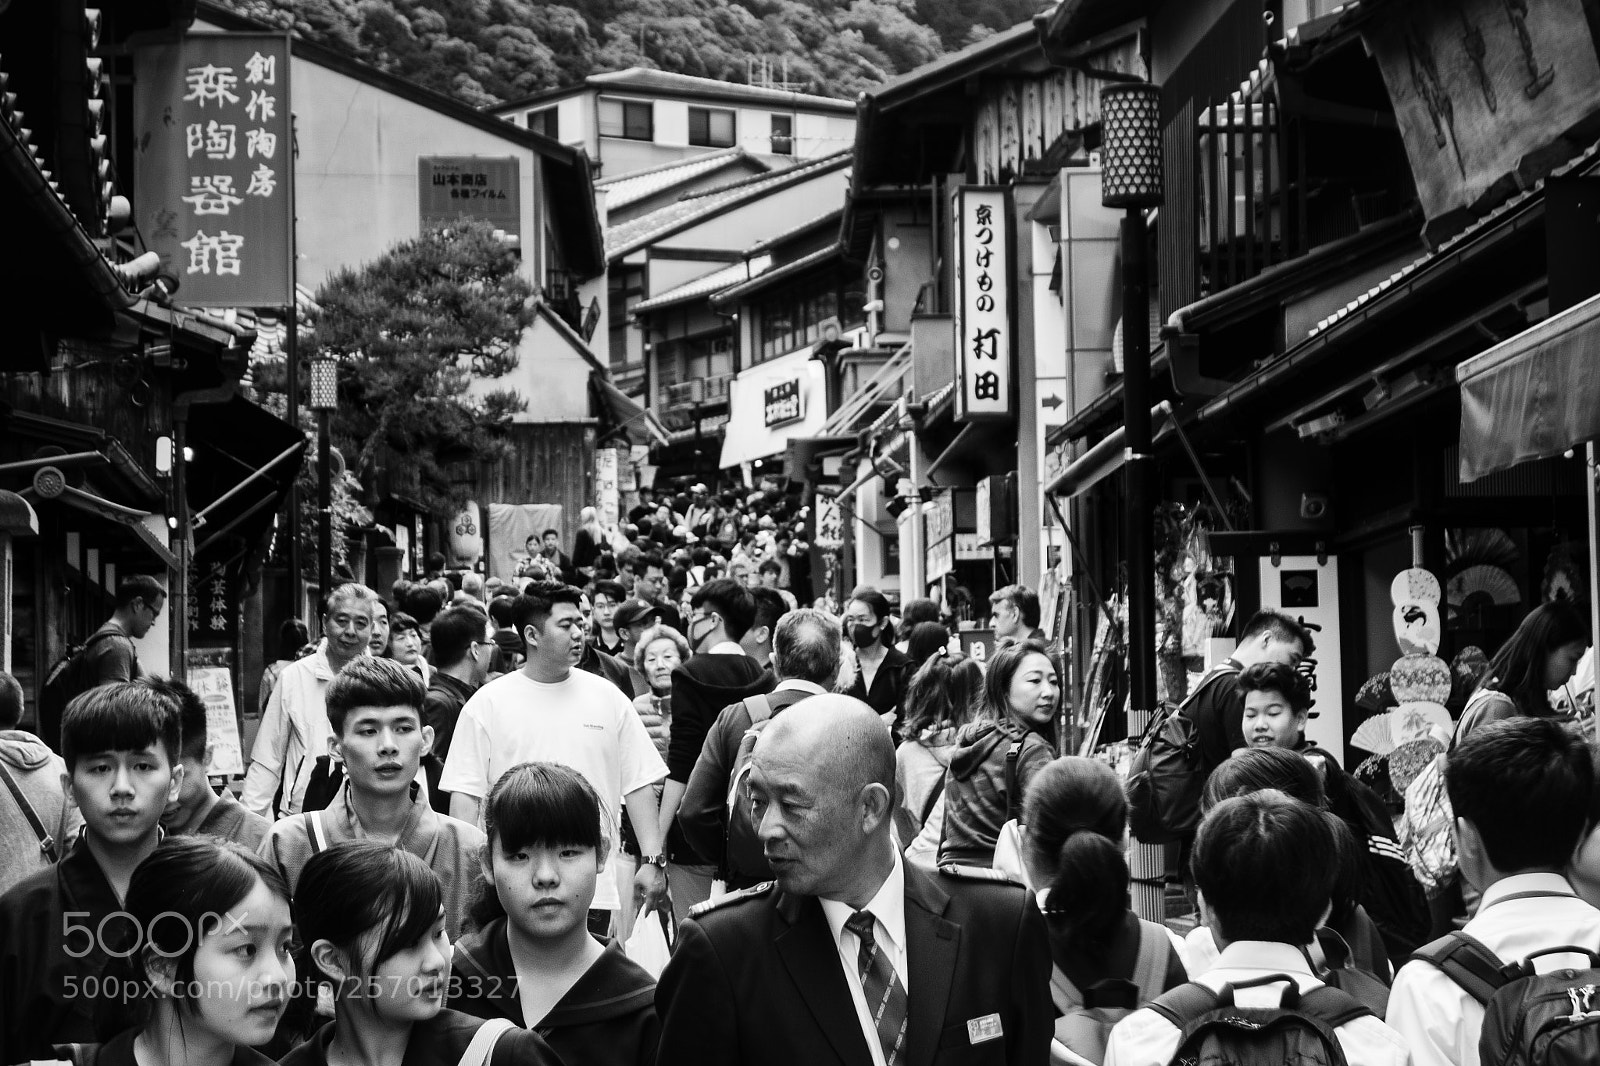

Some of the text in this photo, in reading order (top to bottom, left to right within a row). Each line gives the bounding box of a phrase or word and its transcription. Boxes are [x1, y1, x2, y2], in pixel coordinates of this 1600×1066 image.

[181, 63, 245, 277] 森陶器館
[244, 51, 277, 198] 創作陶房
[432, 173, 488, 187] 山本商店
[972, 203, 1002, 402] 京つけもの 打田
